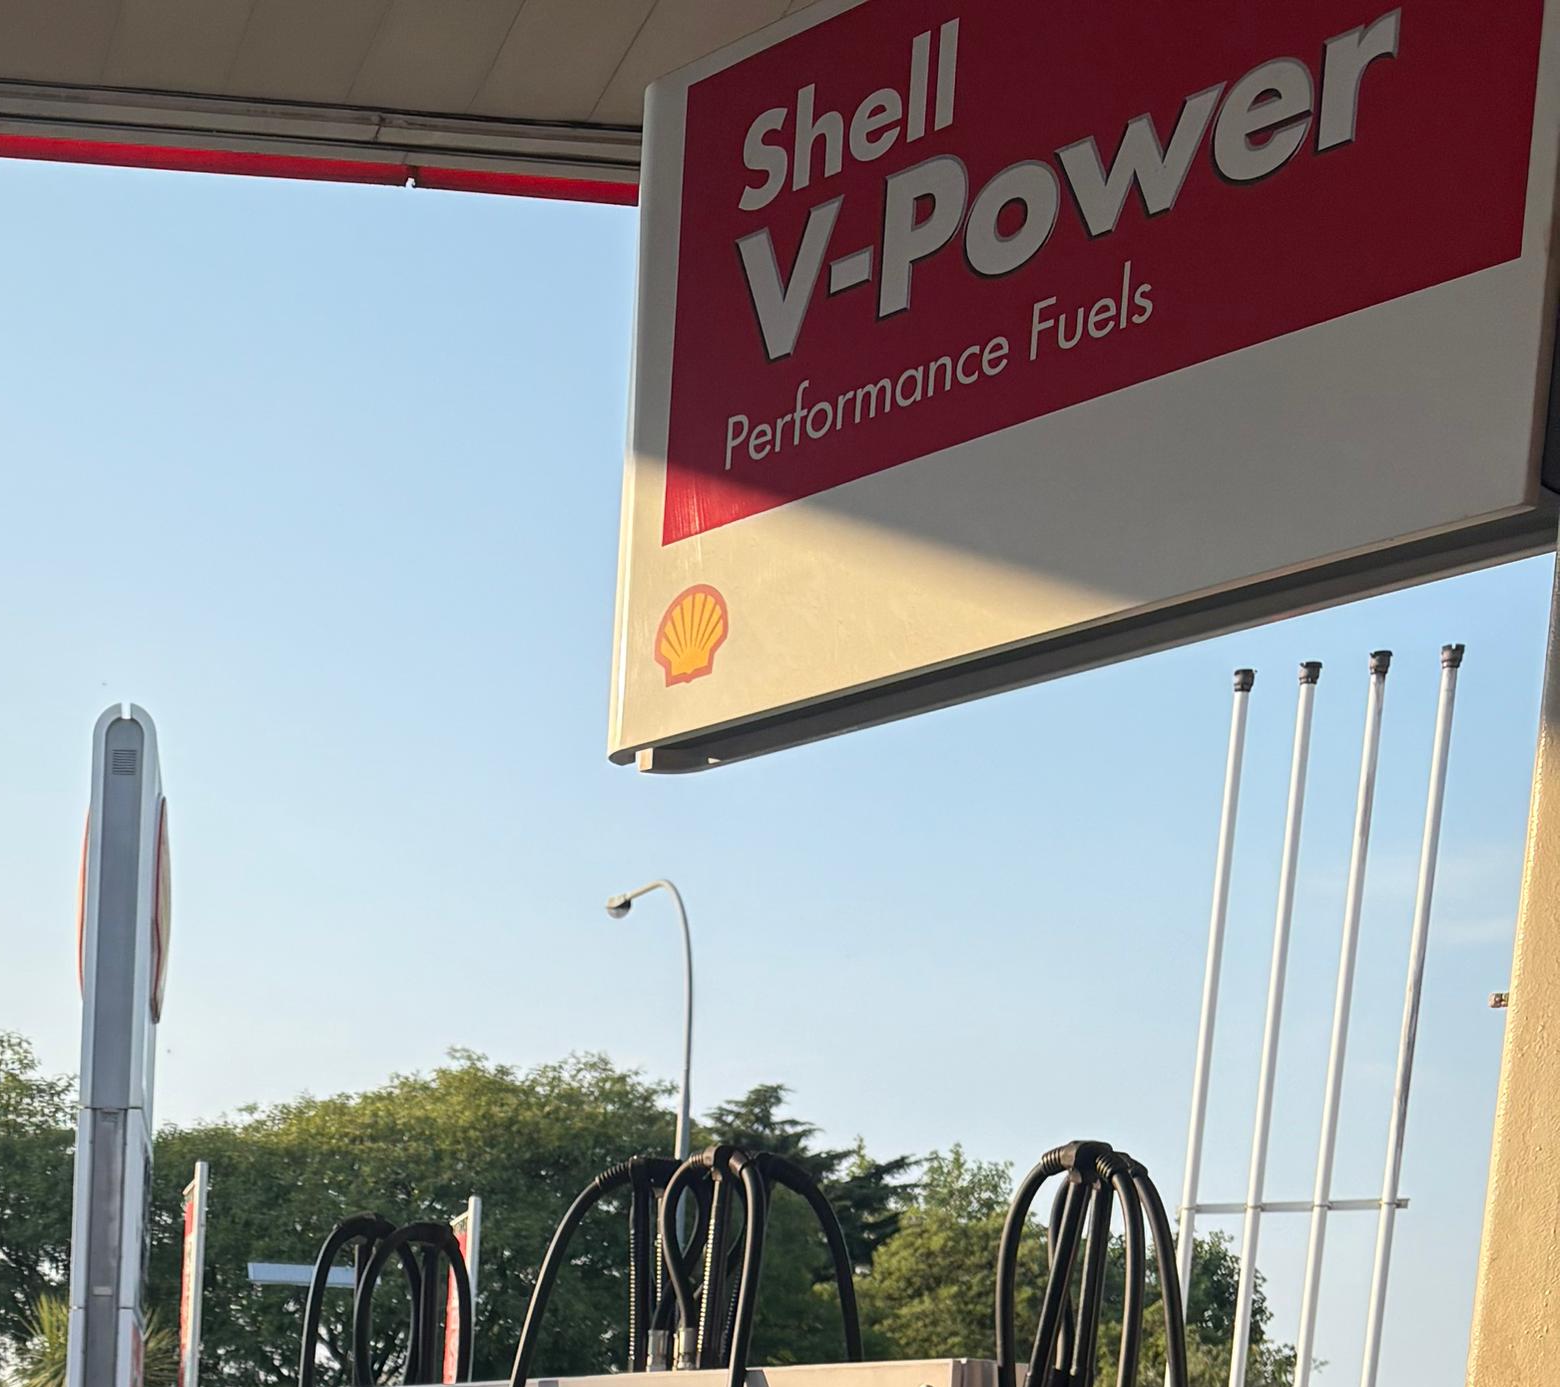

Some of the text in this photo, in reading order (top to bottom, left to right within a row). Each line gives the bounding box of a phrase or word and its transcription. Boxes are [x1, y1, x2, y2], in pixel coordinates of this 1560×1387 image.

[734, 6, 1403, 365] V-Power
[738, 17, 961, 213] Shell
[724, 261, 1155, 472] Performance Fuels
